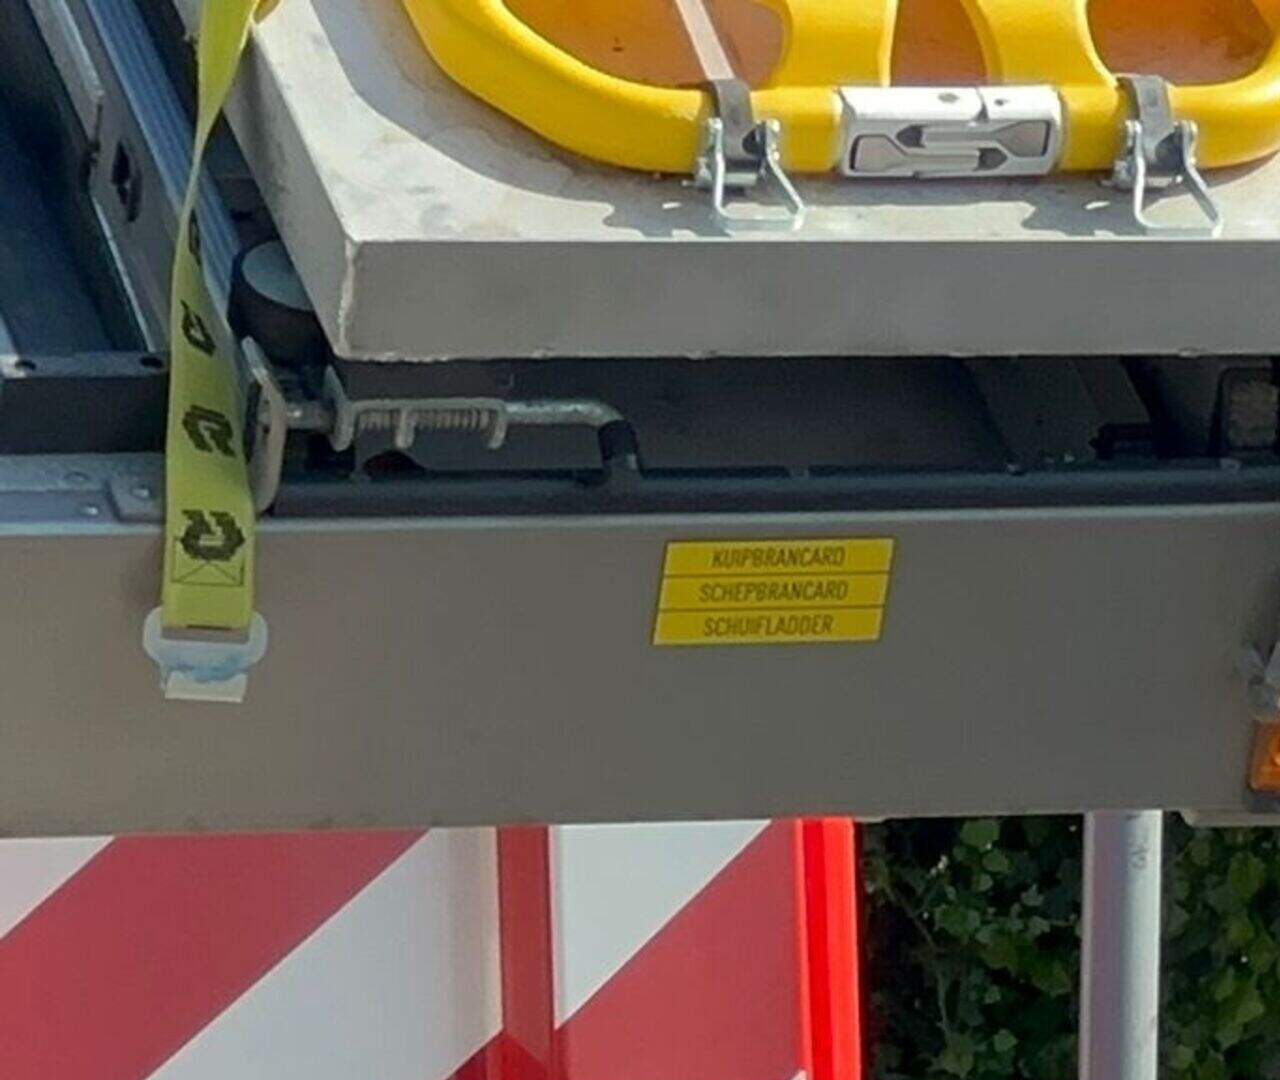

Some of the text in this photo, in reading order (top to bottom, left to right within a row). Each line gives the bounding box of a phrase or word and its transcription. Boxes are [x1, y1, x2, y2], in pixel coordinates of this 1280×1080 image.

[710, 545, 847, 570] KUIPBRANCARD
[698, 580, 849, 604] SCHEPBRANCARD
[704, 613, 835, 637] SCHUIFLADDER
